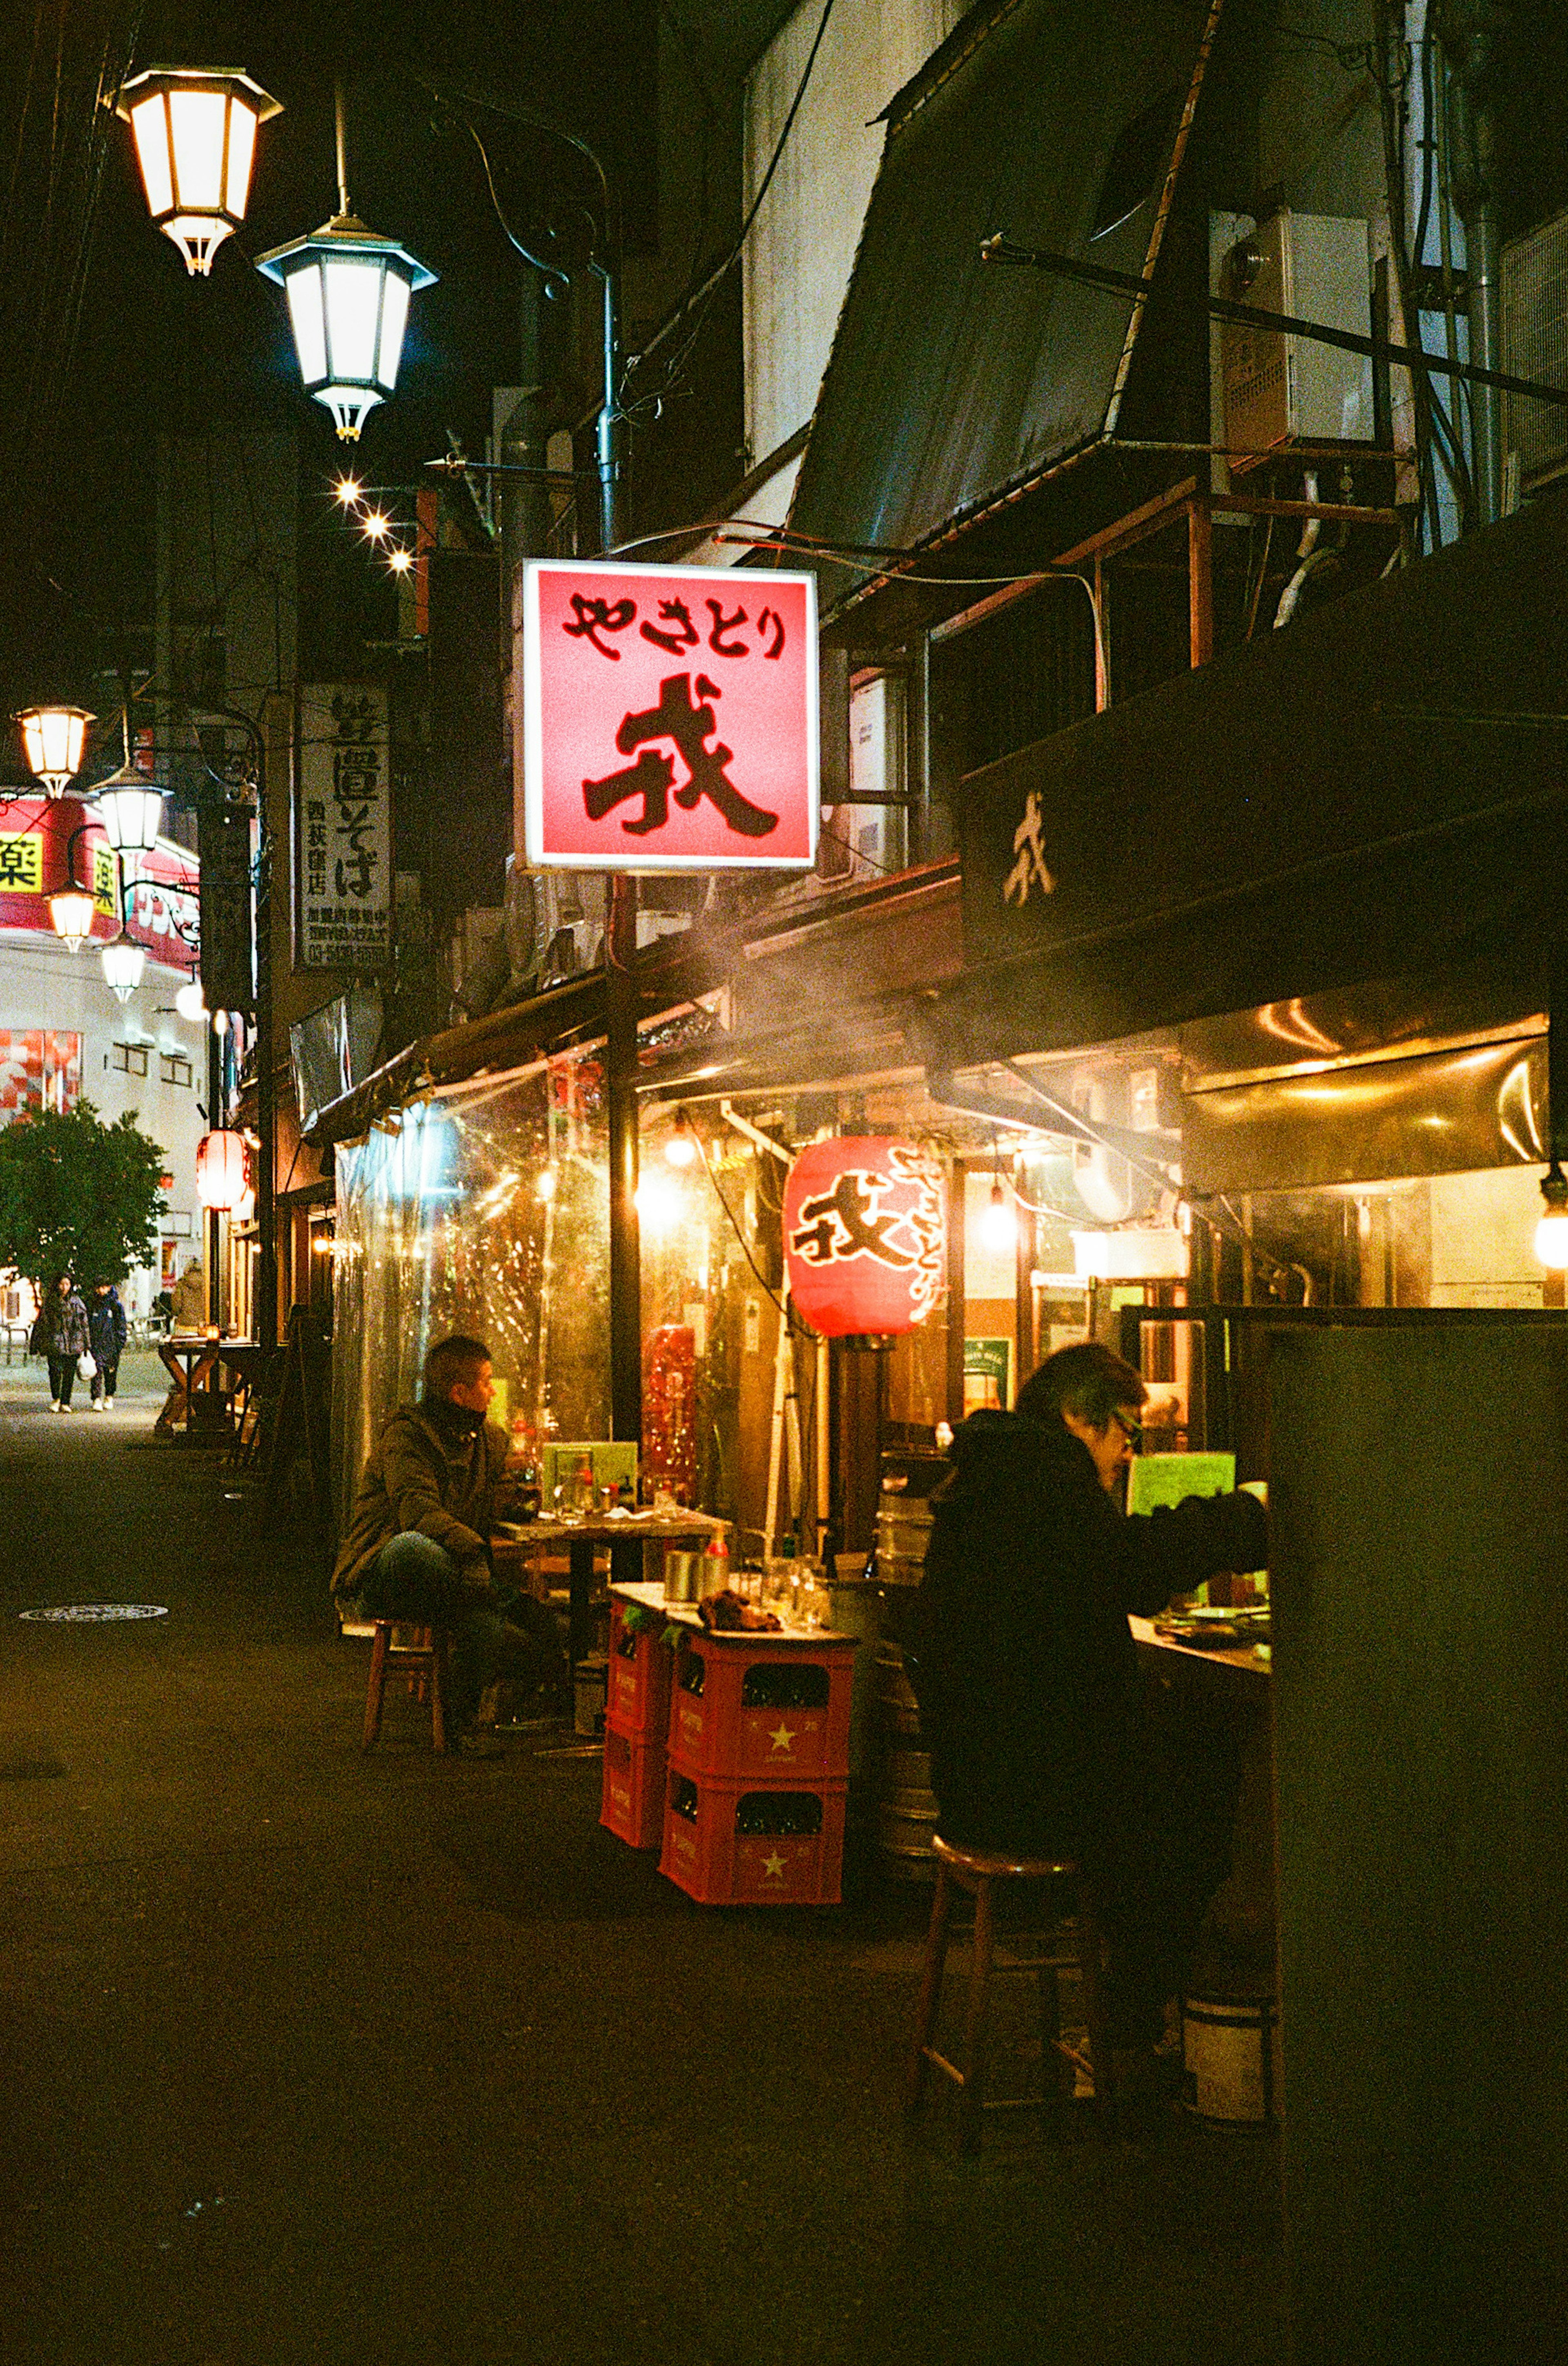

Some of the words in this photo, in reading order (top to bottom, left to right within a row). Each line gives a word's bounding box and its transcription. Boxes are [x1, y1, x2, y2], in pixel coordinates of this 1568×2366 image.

[562, 593, 785, 660] やきとり
[582, 673, 780, 837] 戎
[0, 838, 36, 885] 薬
[1003, 791, 1057, 908] 戎
[790, 1170, 921, 1270] 戎
